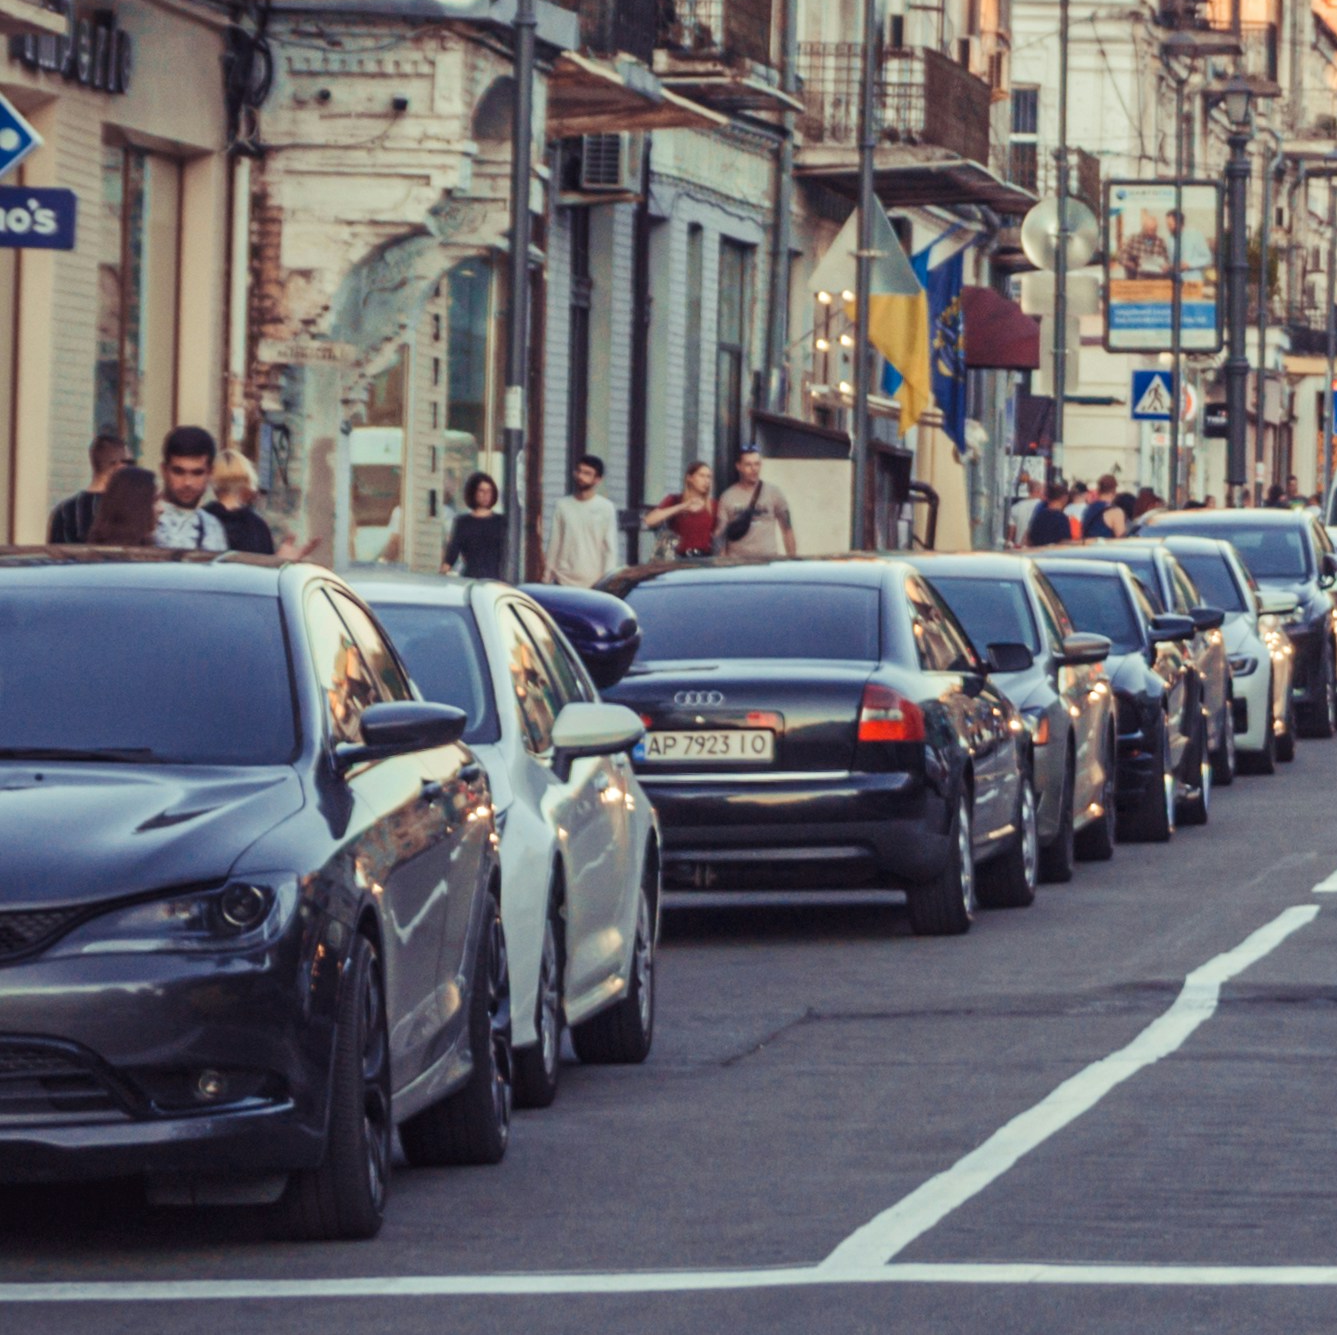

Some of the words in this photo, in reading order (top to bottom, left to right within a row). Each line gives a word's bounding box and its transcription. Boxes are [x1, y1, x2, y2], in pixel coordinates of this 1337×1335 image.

[0, 197, 58, 234] o's
[648, 735, 677, 755] AP
[682, 735, 730, 755] 7923
